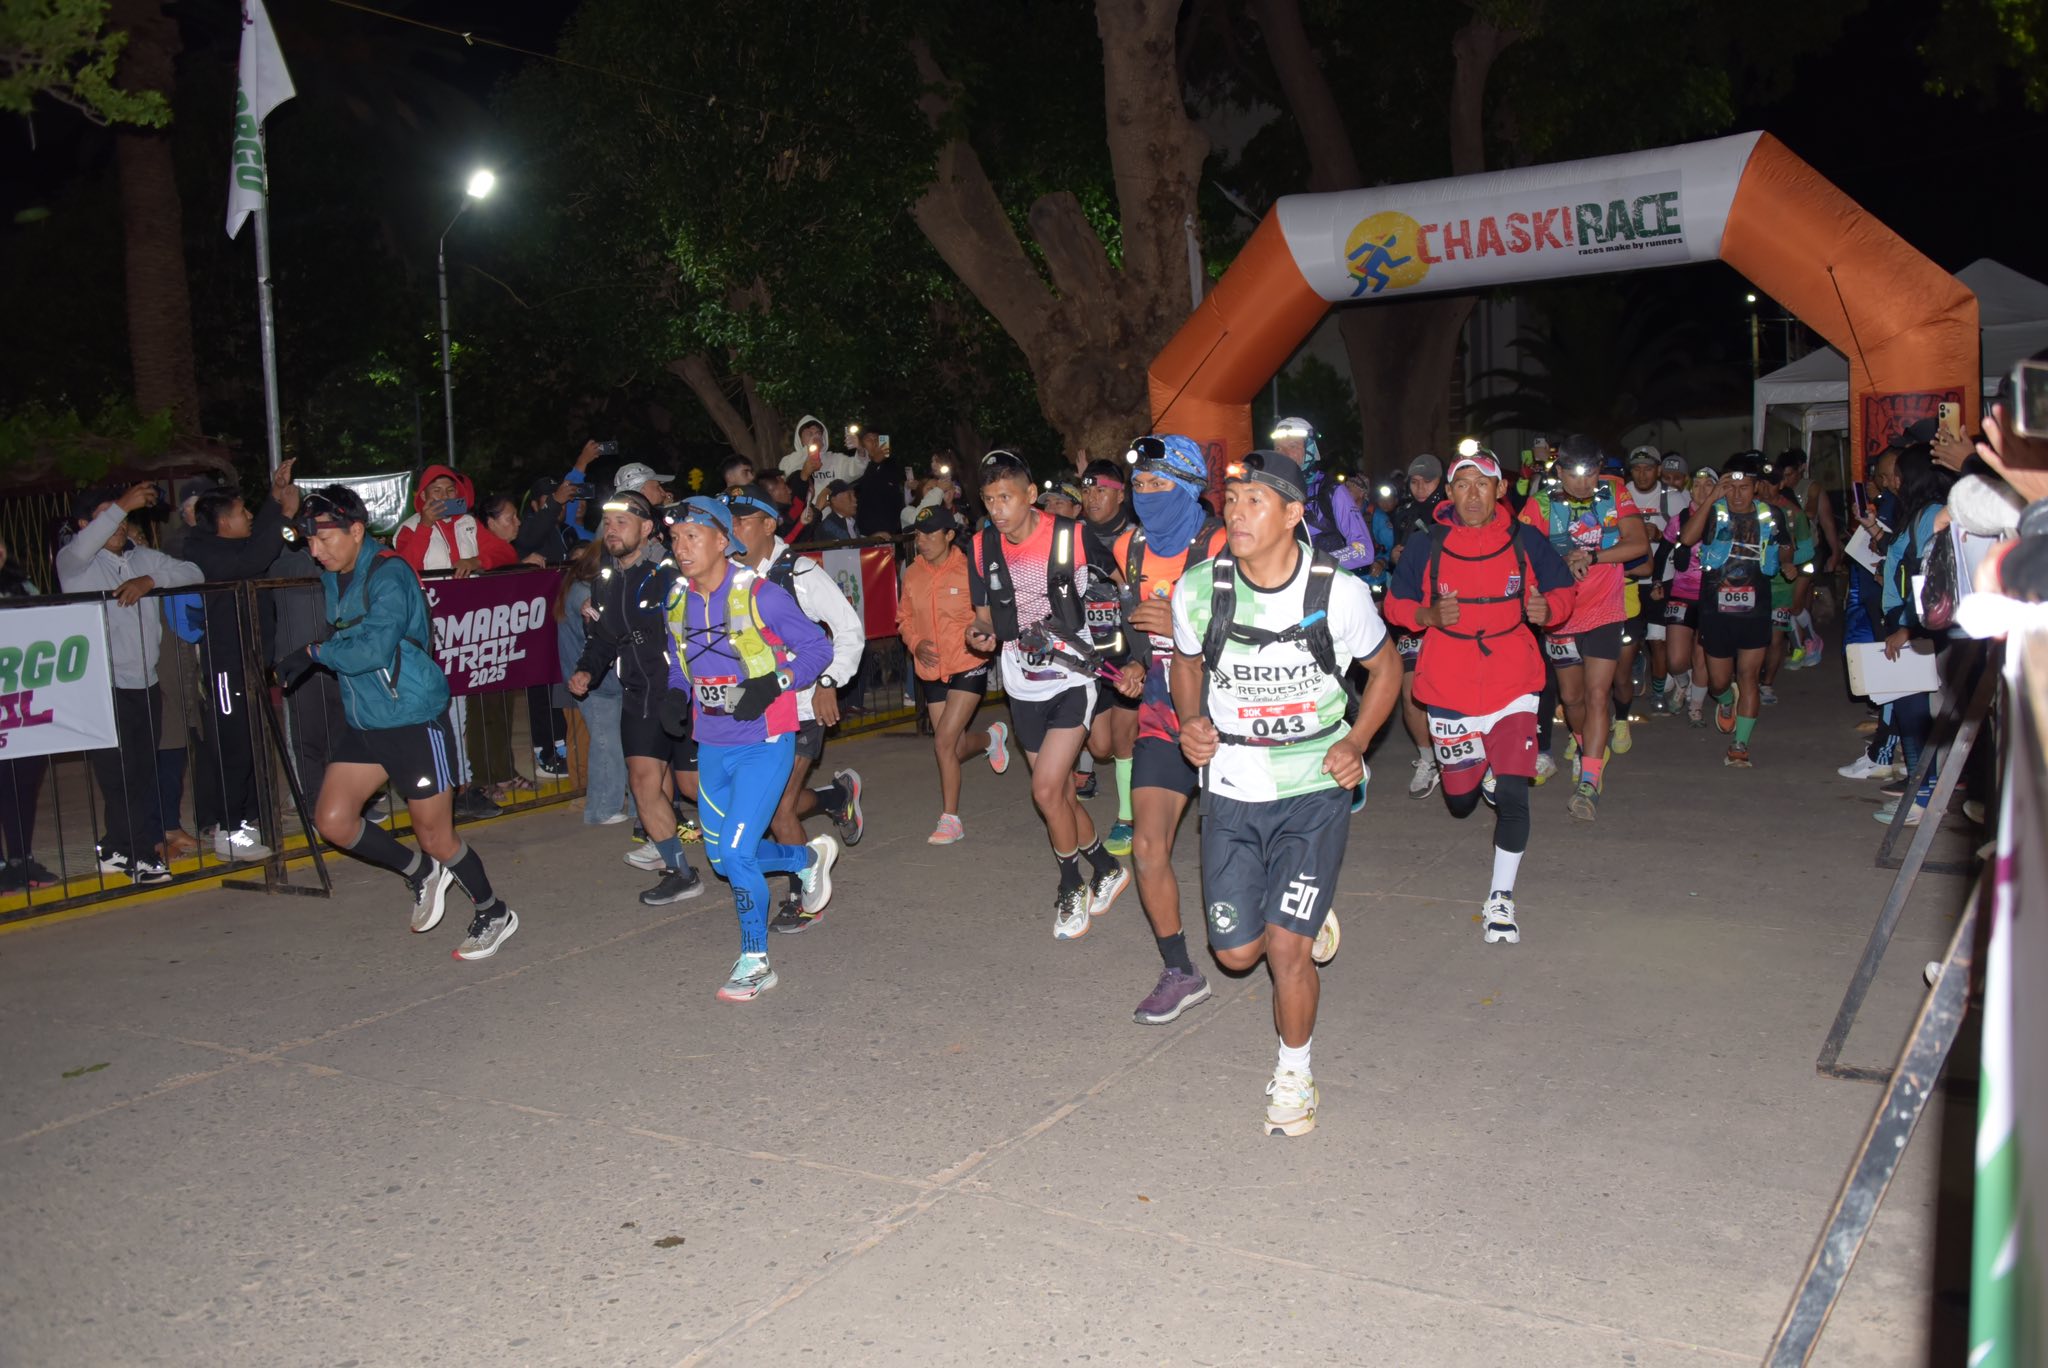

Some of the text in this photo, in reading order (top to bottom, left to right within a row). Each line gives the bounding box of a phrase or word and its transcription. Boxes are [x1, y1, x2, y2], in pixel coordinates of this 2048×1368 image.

[1578, 237, 1683, 255] races make by runners
[1725, 592, 1749, 602] 066
[1087, 610, 1113, 622] 035
[439, 635, 526, 675] TRAIL
[1551, 645, 1569, 656] 001
[468, 663, 507, 688] 2025
[1243, 708, 1262, 718] 30K
[1252, 715, 1306, 737] 043
[1435, 722, 1468, 736] FILA
[1440, 740, 1475, 759] 053
[1280, 880, 1320, 921] 20
